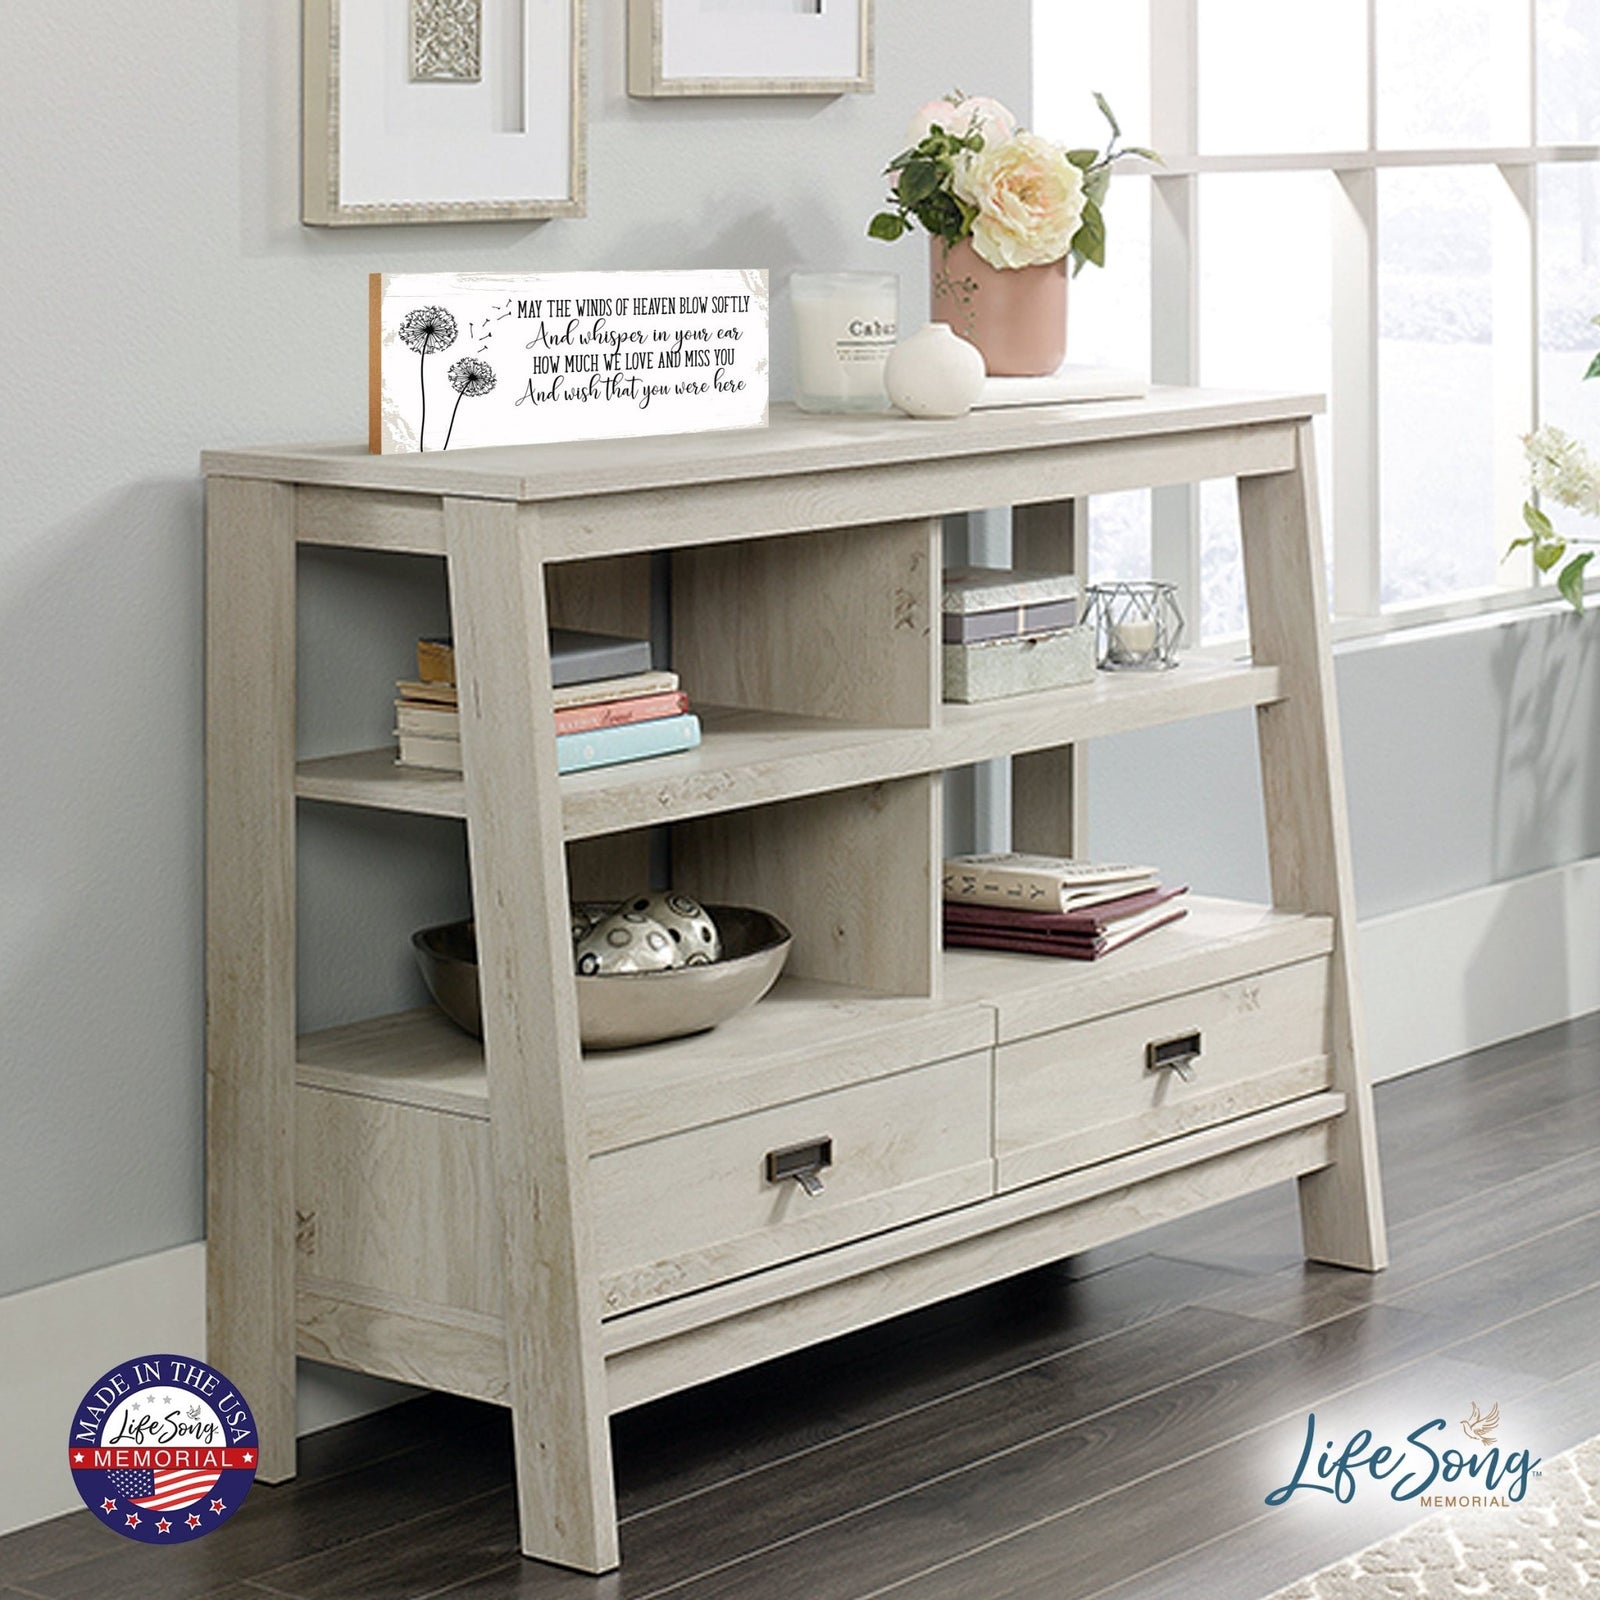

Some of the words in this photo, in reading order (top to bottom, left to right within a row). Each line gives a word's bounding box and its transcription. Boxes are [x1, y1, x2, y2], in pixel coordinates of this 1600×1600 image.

[517, 299, 543, 319] MAY
[546, 299, 572, 318] THE
[575, 298, 613, 317] WINDS
[615, 298, 630, 316] OF
[632, 296, 676, 315] HEAVEN
[679, 296, 709, 314] BLOW
[711, 295, 751, 314] SOFTLY
[525, 318, 580, 349] And
[579, 317, 649, 356] whisper
[653, 329, 671, 342] in
[670, 328, 713, 354] your
[716, 327, 744, 341] ear
[532, 355, 561, 375] HOW
[564, 354, 599, 373] MUCH
[602, 352, 622, 371] WE
[625, 351, 654, 371] LOVE
[657, 350, 681, 369] AND
[684, 349, 711, 368] MISS
[713, 348, 735, 366] YOU
[514, 374, 565, 407] And
[563, 372, 602, 403] wish
[600, 371, 644, 401] that
[638, 384, 671, 410] you
[674, 381, 710, 396] were
[713, 367, 746, 393] here
